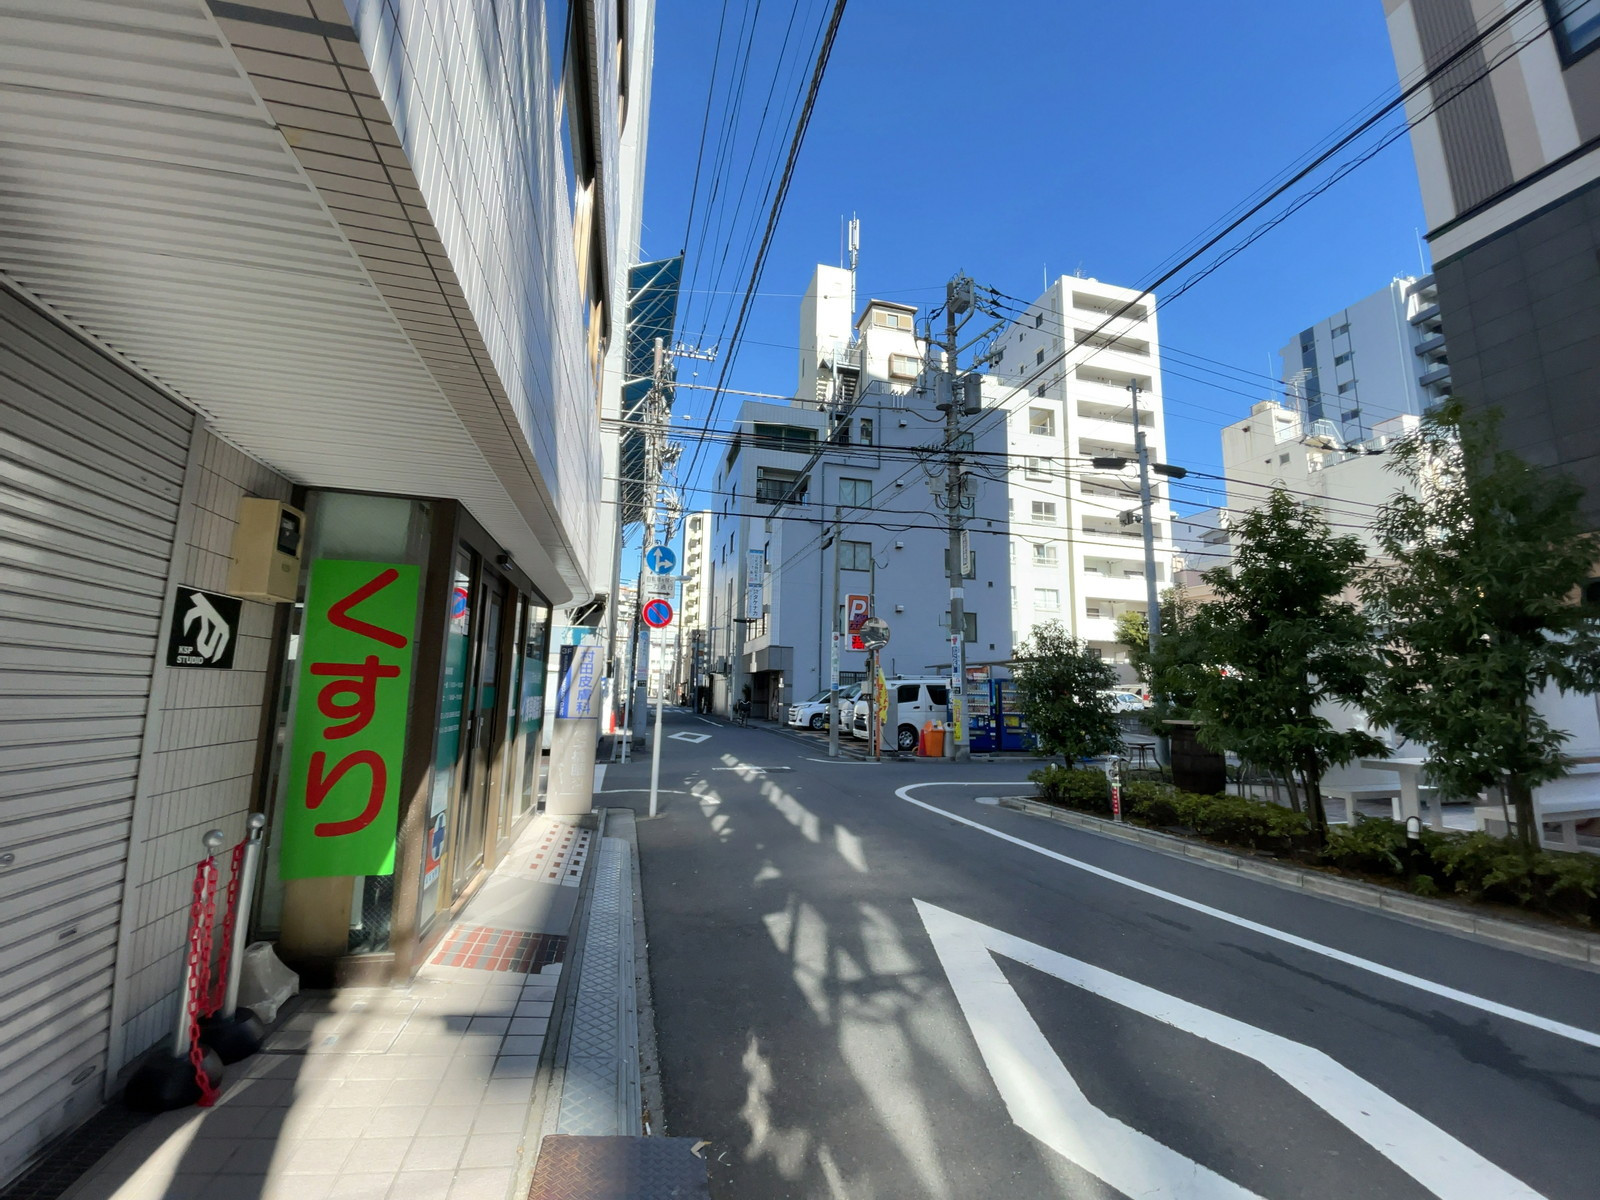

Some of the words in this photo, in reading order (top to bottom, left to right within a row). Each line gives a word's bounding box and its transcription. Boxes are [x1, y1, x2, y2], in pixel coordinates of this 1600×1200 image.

[850, 600, 867, 621] P
[178, 645, 193, 654] KSP
[561, 647, 573, 655] 3F
[176, 655, 204, 665] STUDIO
[575, 650, 595, 715] 村田皮膚科
[305, 568, 408, 838] くすり
